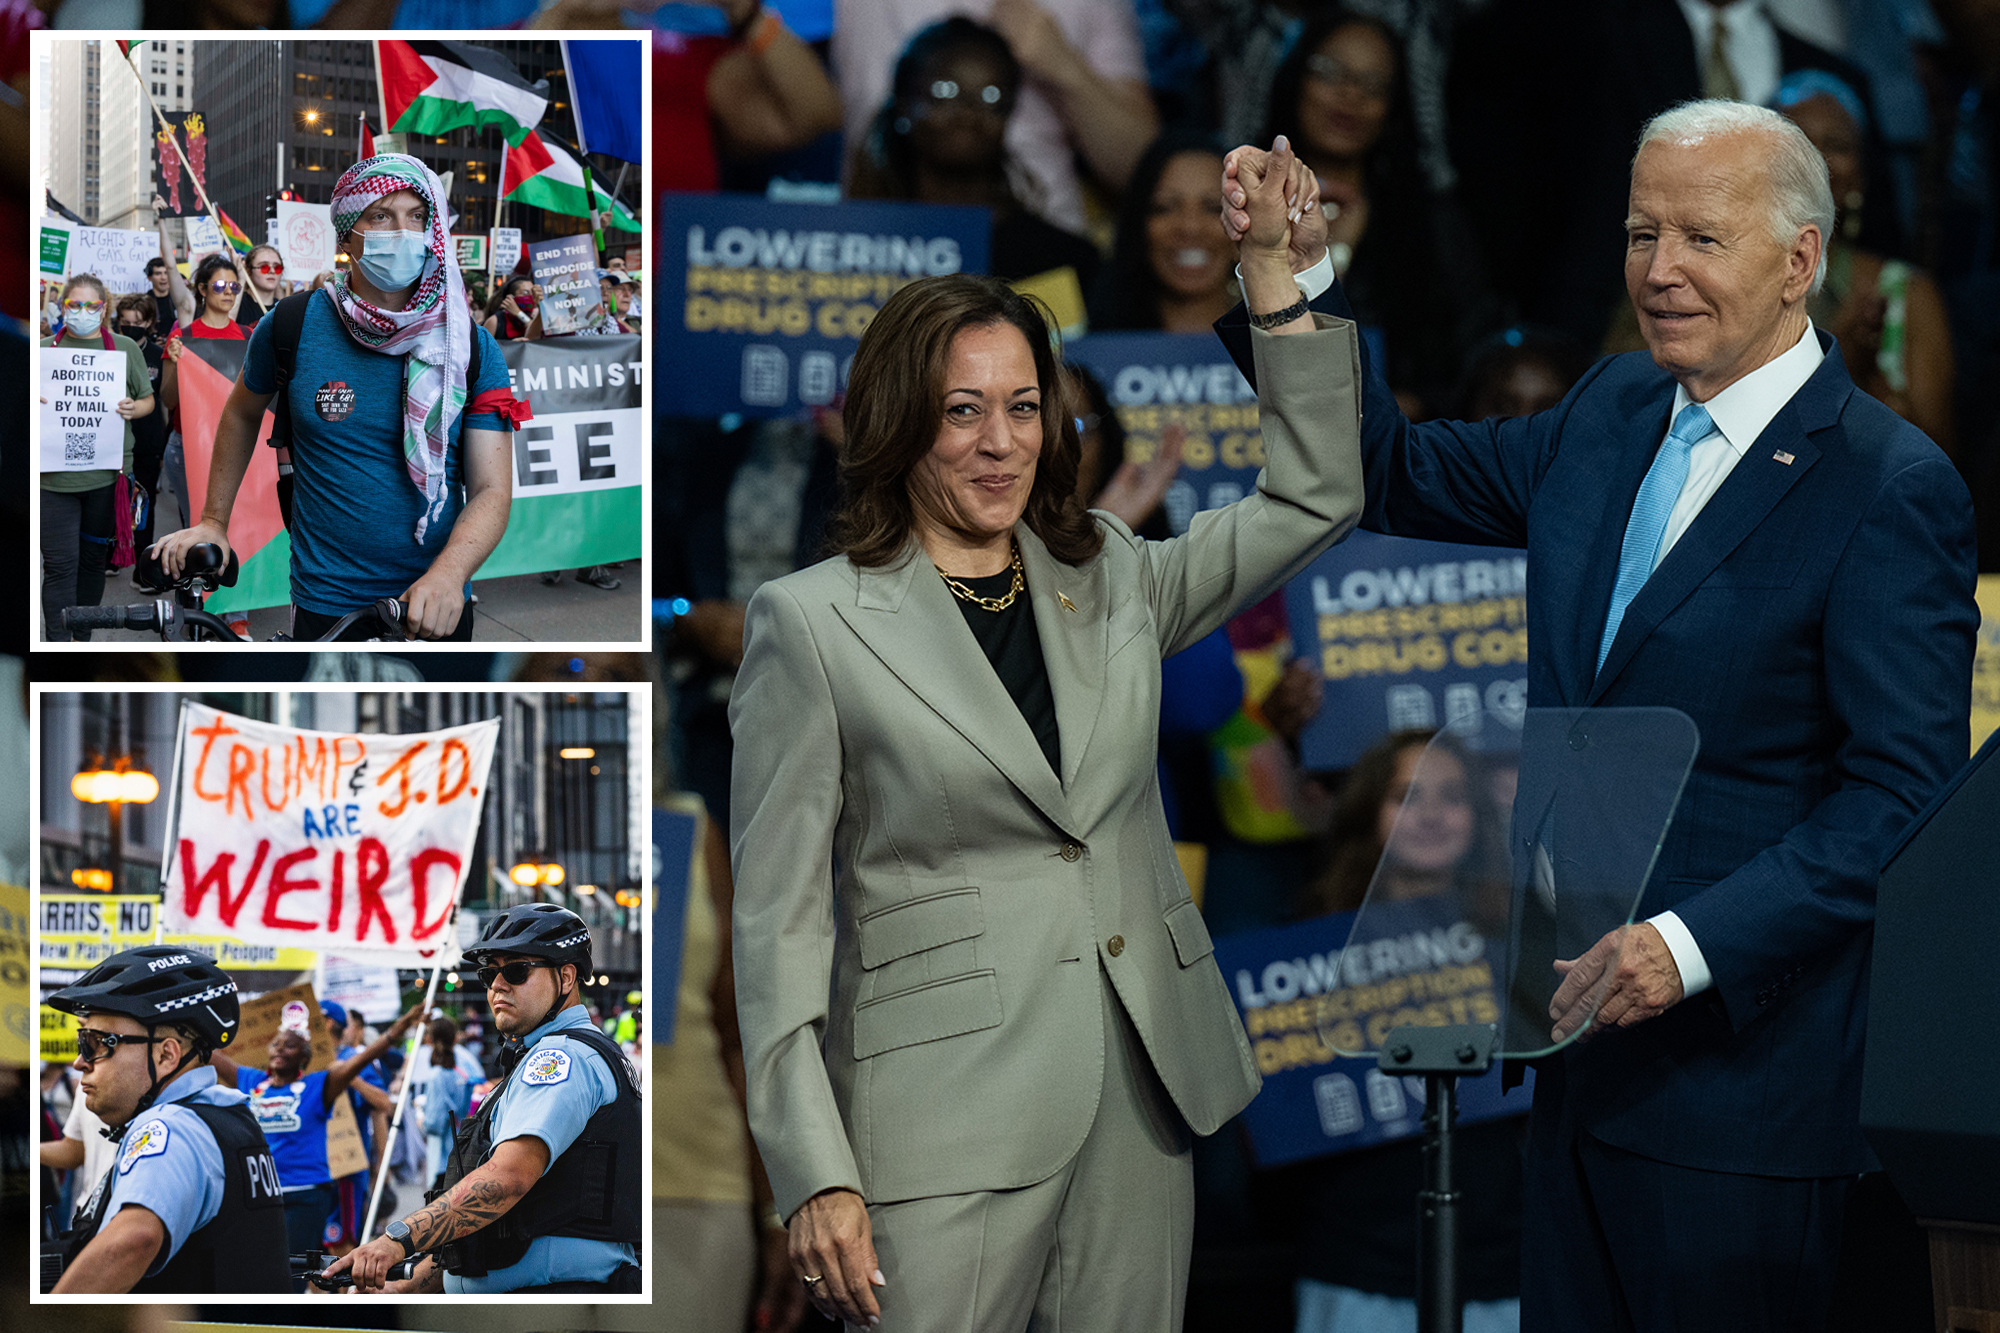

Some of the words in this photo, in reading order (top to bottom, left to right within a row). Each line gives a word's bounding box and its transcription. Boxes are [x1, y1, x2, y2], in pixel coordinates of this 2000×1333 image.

[80, 230, 126, 248] RIGHTS
[536, 249, 561, 261] END
[563, 245, 587, 256] THE
[687, 225, 963, 276] LOWERING
[534, 261, 595, 278] GENOCIDE
[543, 284, 557, 294] IN
[560, 279, 592, 291] GAZA
[687, 265, 906, 299] PRESCRIPTI
[554, 297, 586, 310] NOW!
[685, 296, 812, 336] DRUG
[71, 354, 96, 366] GET
[51, 369, 115, 382] ABORTION
[508, 361, 642, 393] EMINIST
[64, 385, 101, 397] PILLS
[316, 394, 336, 402] LIKE
[339, 394, 355, 402] 68!
[55, 400, 72, 412] BY
[77, 402, 109, 413] MAIL
[60, 416, 102, 428] TODAY
[513, 421, 616, 487] EE
[1321, 638, 1447, 681] DRUG
[377, 738, 478, 818] J.D.
[303, 804, 361, 839] ARE
[179, 837, 463, 944] WEIRD
[120, 903, 151, 931] NO
[147, 954, 192, 973] POLICE
[1236, 921, 1486, 1008] LOWERING
[528, 1051, 566, 1068] CHICAGO
[528, 1070, 562, 1081] POLICE
